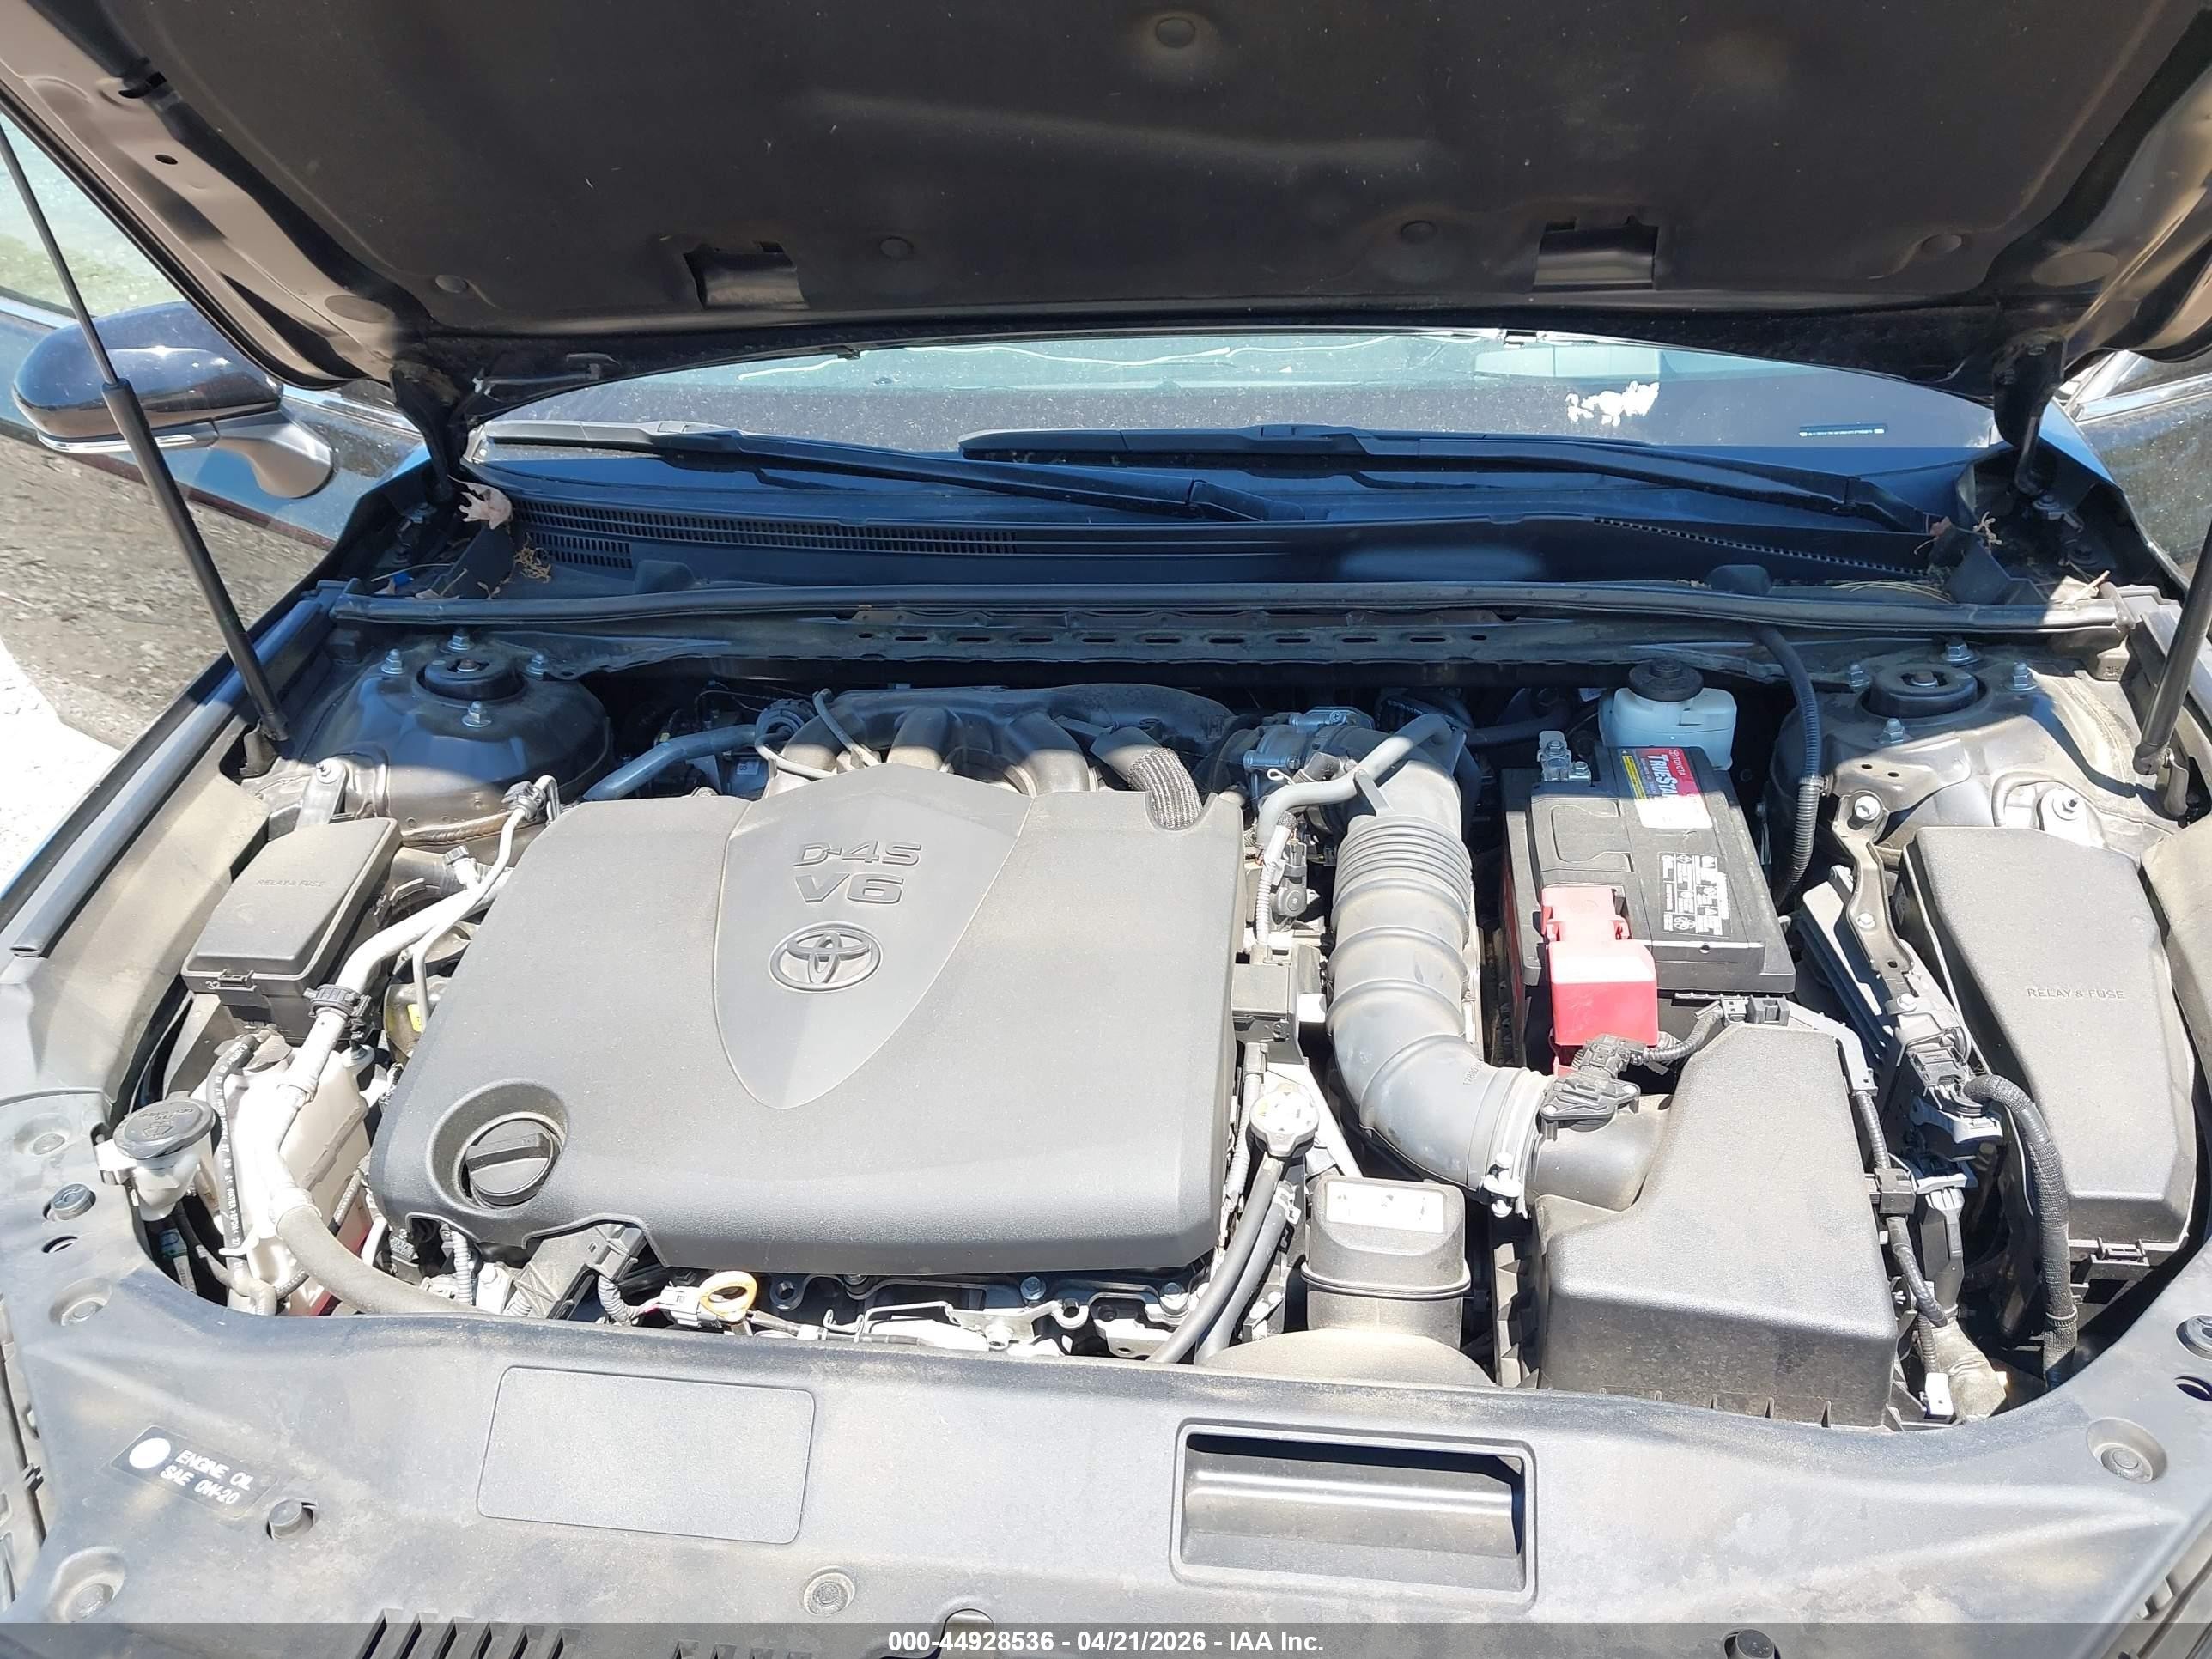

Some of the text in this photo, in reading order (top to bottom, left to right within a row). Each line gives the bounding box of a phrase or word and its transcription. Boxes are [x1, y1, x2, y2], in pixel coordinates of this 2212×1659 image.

[1673, 756, 1687, 776] TOYOTA
[793, 840, 922, 866] D-4S
[256, 879, 289, 888] RELAY
[298, 879, 326, 888] FUSE
[794, 872, 906, 905] V6
[2026, 988, 2126, 1000] RELAY & FUSE
[227, 1187, 237, 1210] WATER
[175, 1449, 254, 1491] ENGINE OIL
[160, 1464, 240, 1504] SAE 0W-20
